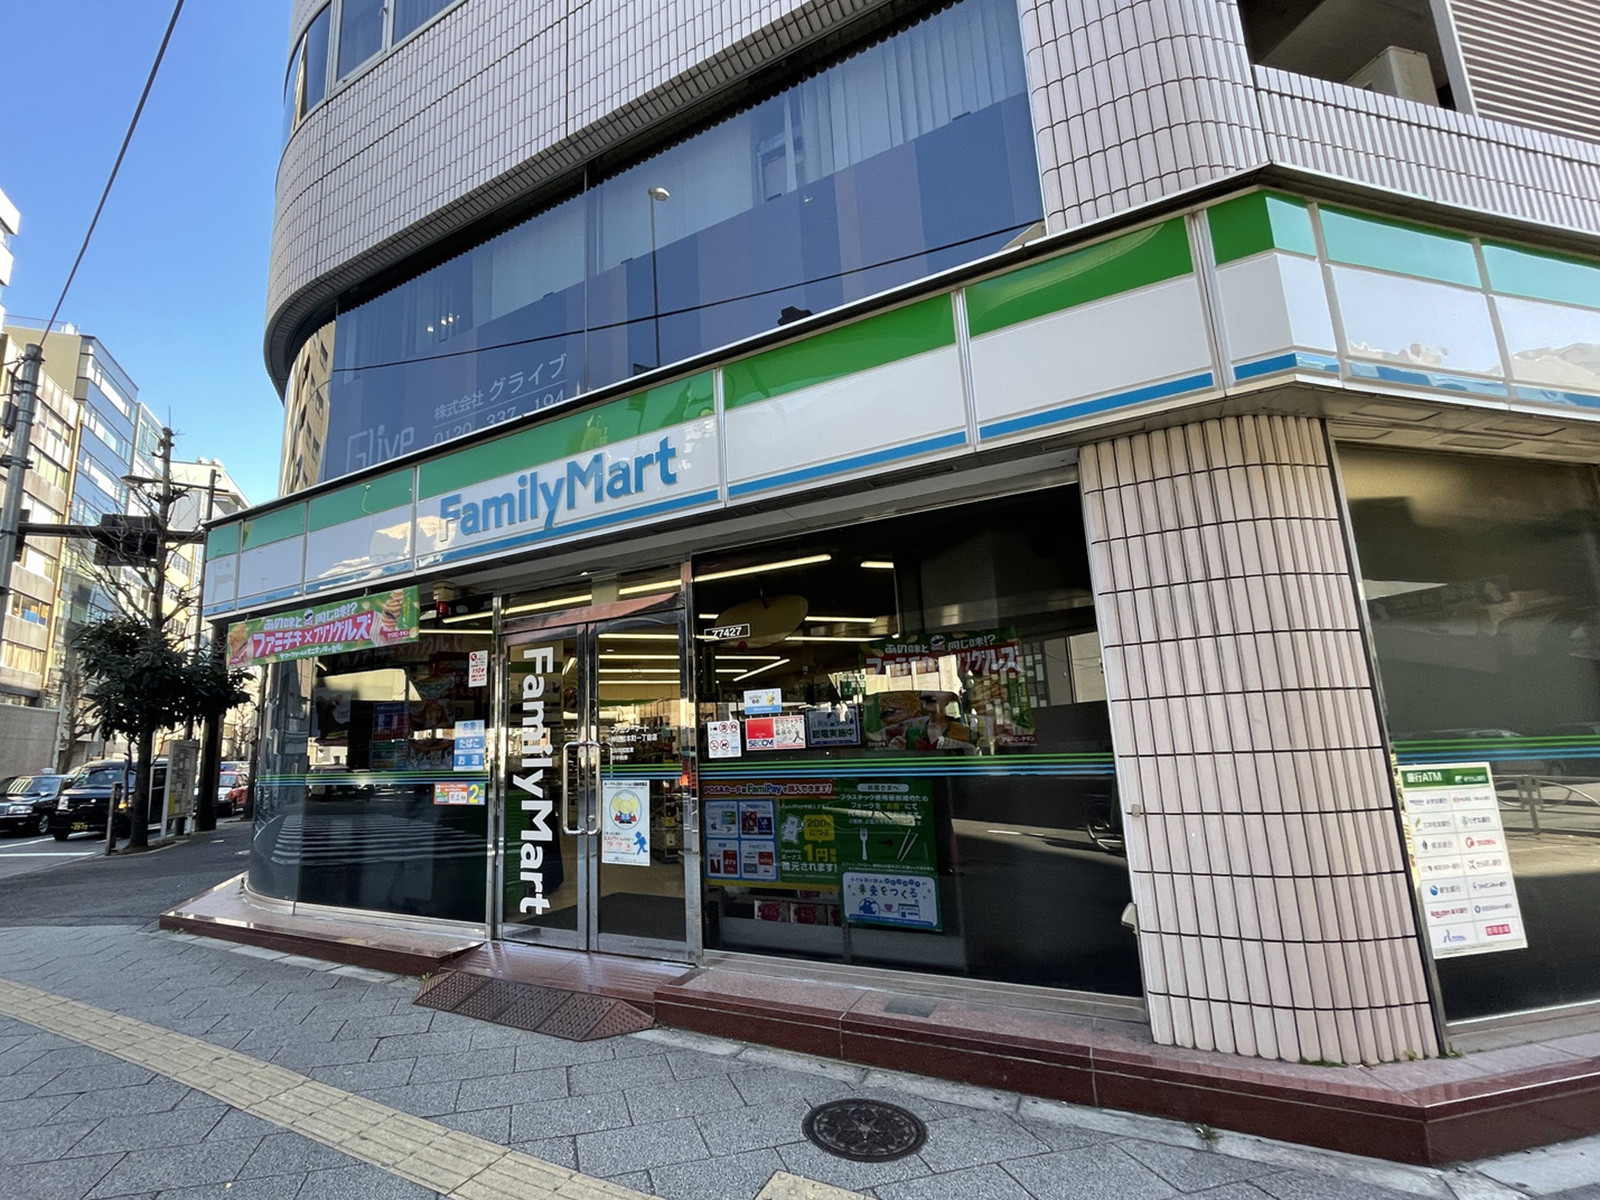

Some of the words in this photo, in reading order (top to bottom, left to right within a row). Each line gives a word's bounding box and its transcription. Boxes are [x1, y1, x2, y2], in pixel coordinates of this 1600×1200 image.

[433, 389, 484, 421] 株式会社
[489, 352, 567, 401] グライブ
[533, 389, 564, 411] 194
[439, 435, 677, 541] FamilyMart
[264, 616, 302, 631] あの味と
[712, 626, 742, 638] 77427
[884, 643, 929, 653] あの味と
[458, 738, 480, 749] たばこ
[748, 739, 774, 747] SECOM
[512, 646, 554, 915] FamilyMart
[469, 784, 479, 804] 2
[858, 883, 918, 900] 未来をつくる
